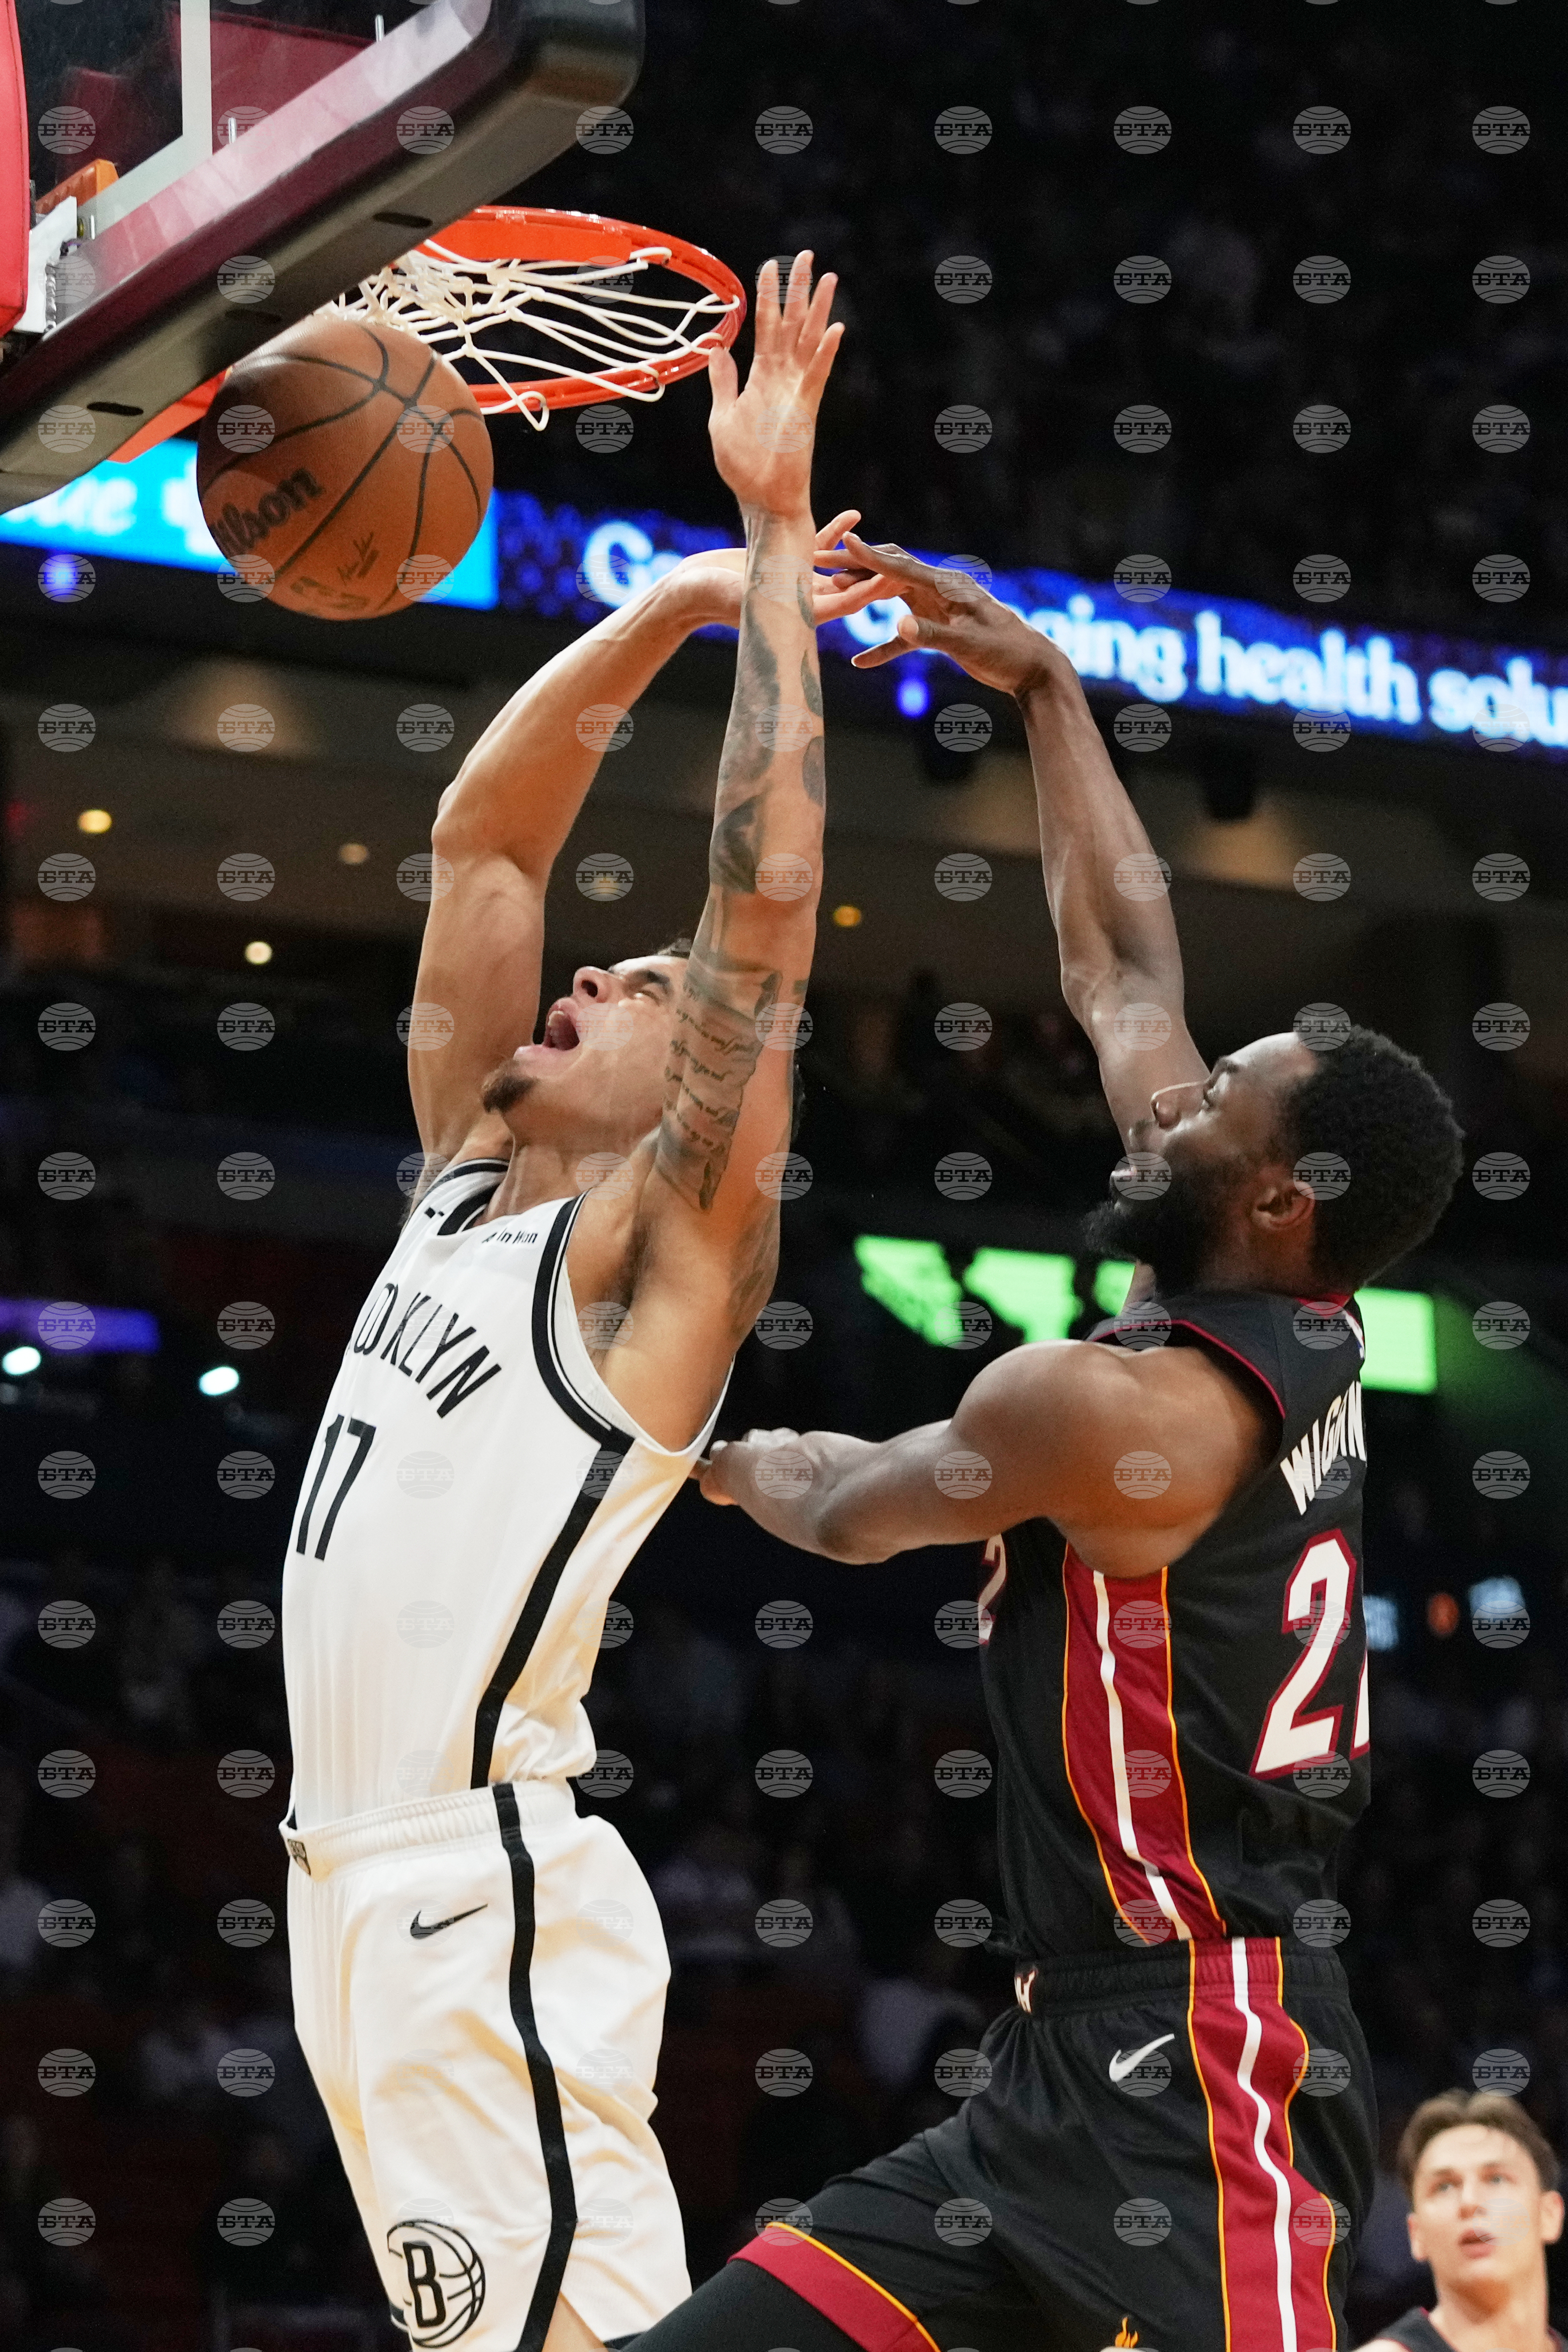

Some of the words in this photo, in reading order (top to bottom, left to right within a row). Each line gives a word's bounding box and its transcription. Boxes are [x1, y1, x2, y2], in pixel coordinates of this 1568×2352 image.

[1195, 610, 1421, 725] health
[346, 1283, 502, 1419] OOKLYN
[296, 1414, 377, 1562] 17
